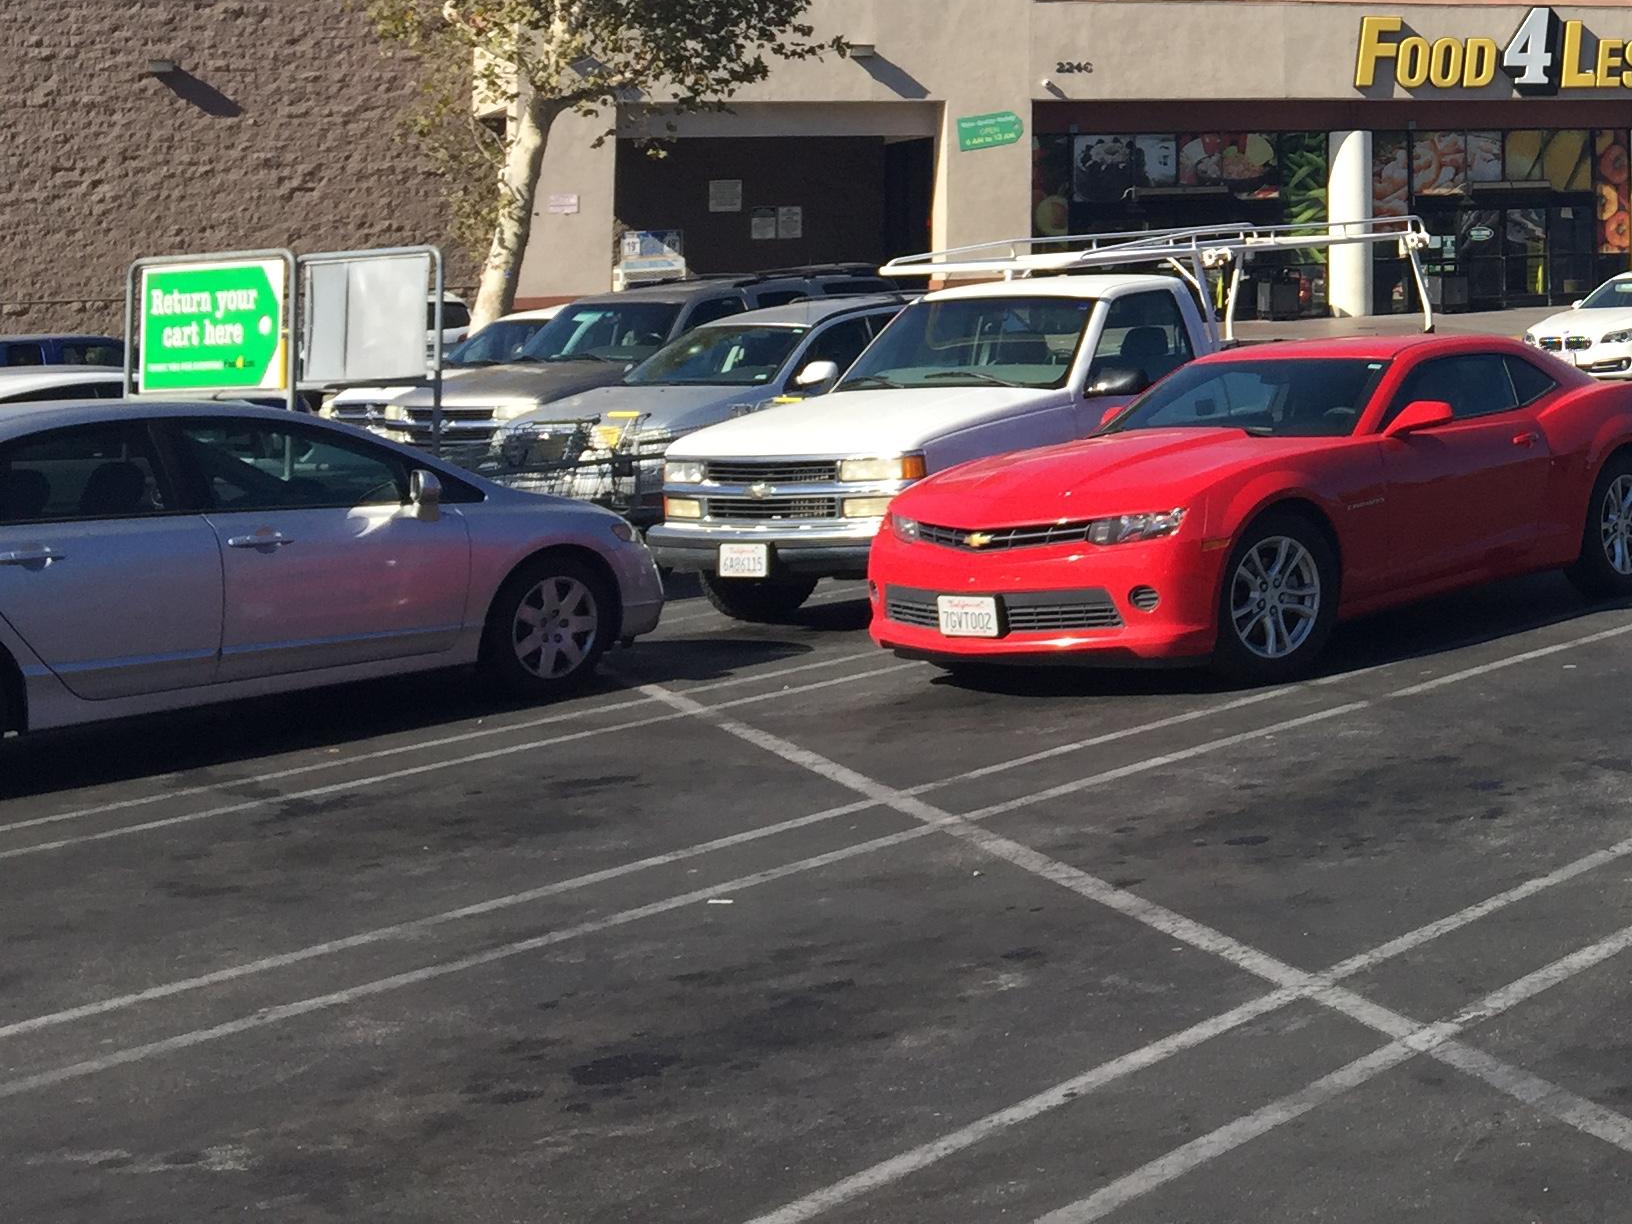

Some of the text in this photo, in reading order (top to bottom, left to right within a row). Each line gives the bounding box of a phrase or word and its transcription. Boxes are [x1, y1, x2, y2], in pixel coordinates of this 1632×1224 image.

[1502, 6, 1553, 87] 4
[150, 288, 259, 319] Return your
[162, 317, 244, 349] cart here
[942, 610, 993, 631] 7GVT002
